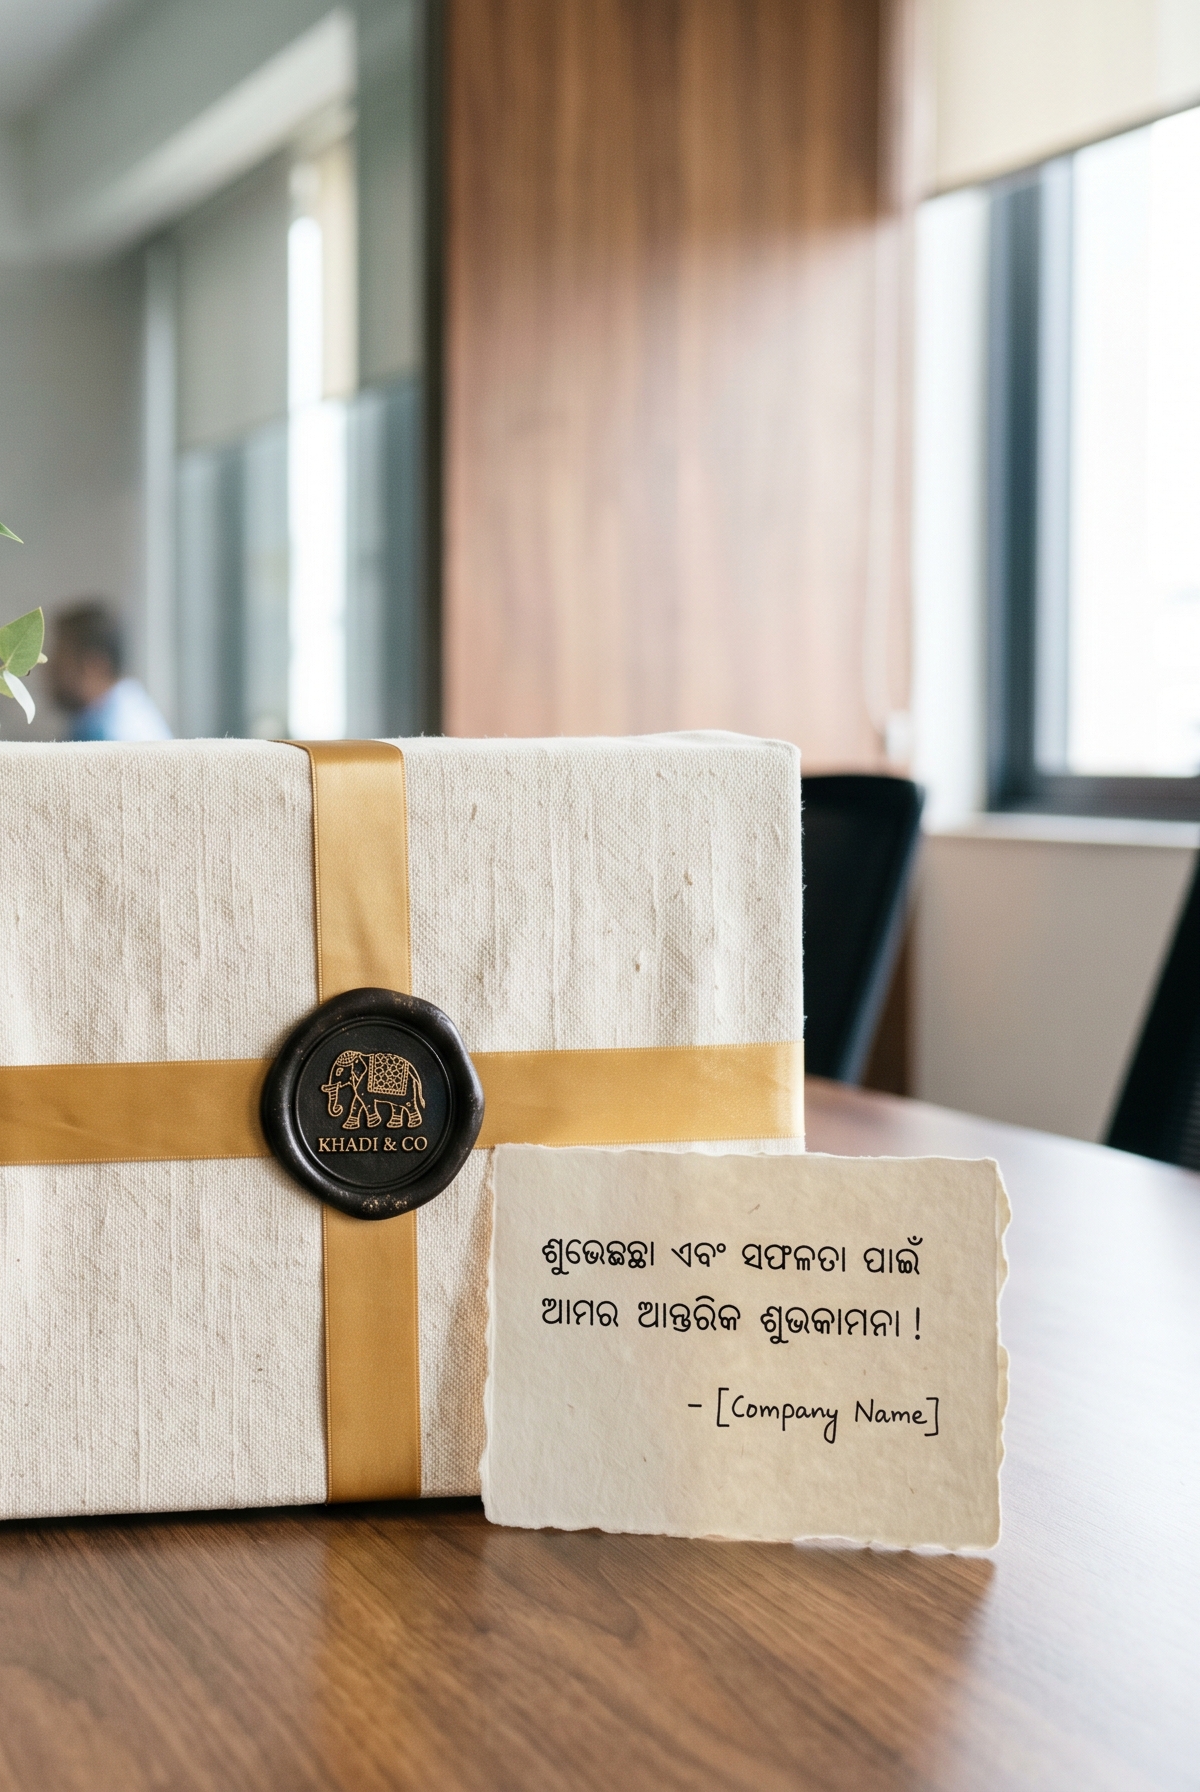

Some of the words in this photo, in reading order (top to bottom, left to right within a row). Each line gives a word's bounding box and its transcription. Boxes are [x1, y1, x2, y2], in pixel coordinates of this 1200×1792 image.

[318, 1137, 378, 1152] KHADI
[383, 1136, 397, 1151] &
[401, 1136, 428, 1151] CO
[670, 1242, 727, 1268] ଏବଂ
[741, 1243, 846, 1273] ସଫଳତା
[863, 1235, 925, 1276] ପାଇଁ
[541, 1297, 619, 1328] ଆମର
[637, 1295, 741, 1333] ଆନ୍ତରିକ
[759, 1305, 900, 1345] ଶୁଭକାମନା
[716, 1387, 839, 1445] [Company
[854, 1396, 940, 1437] Name]
